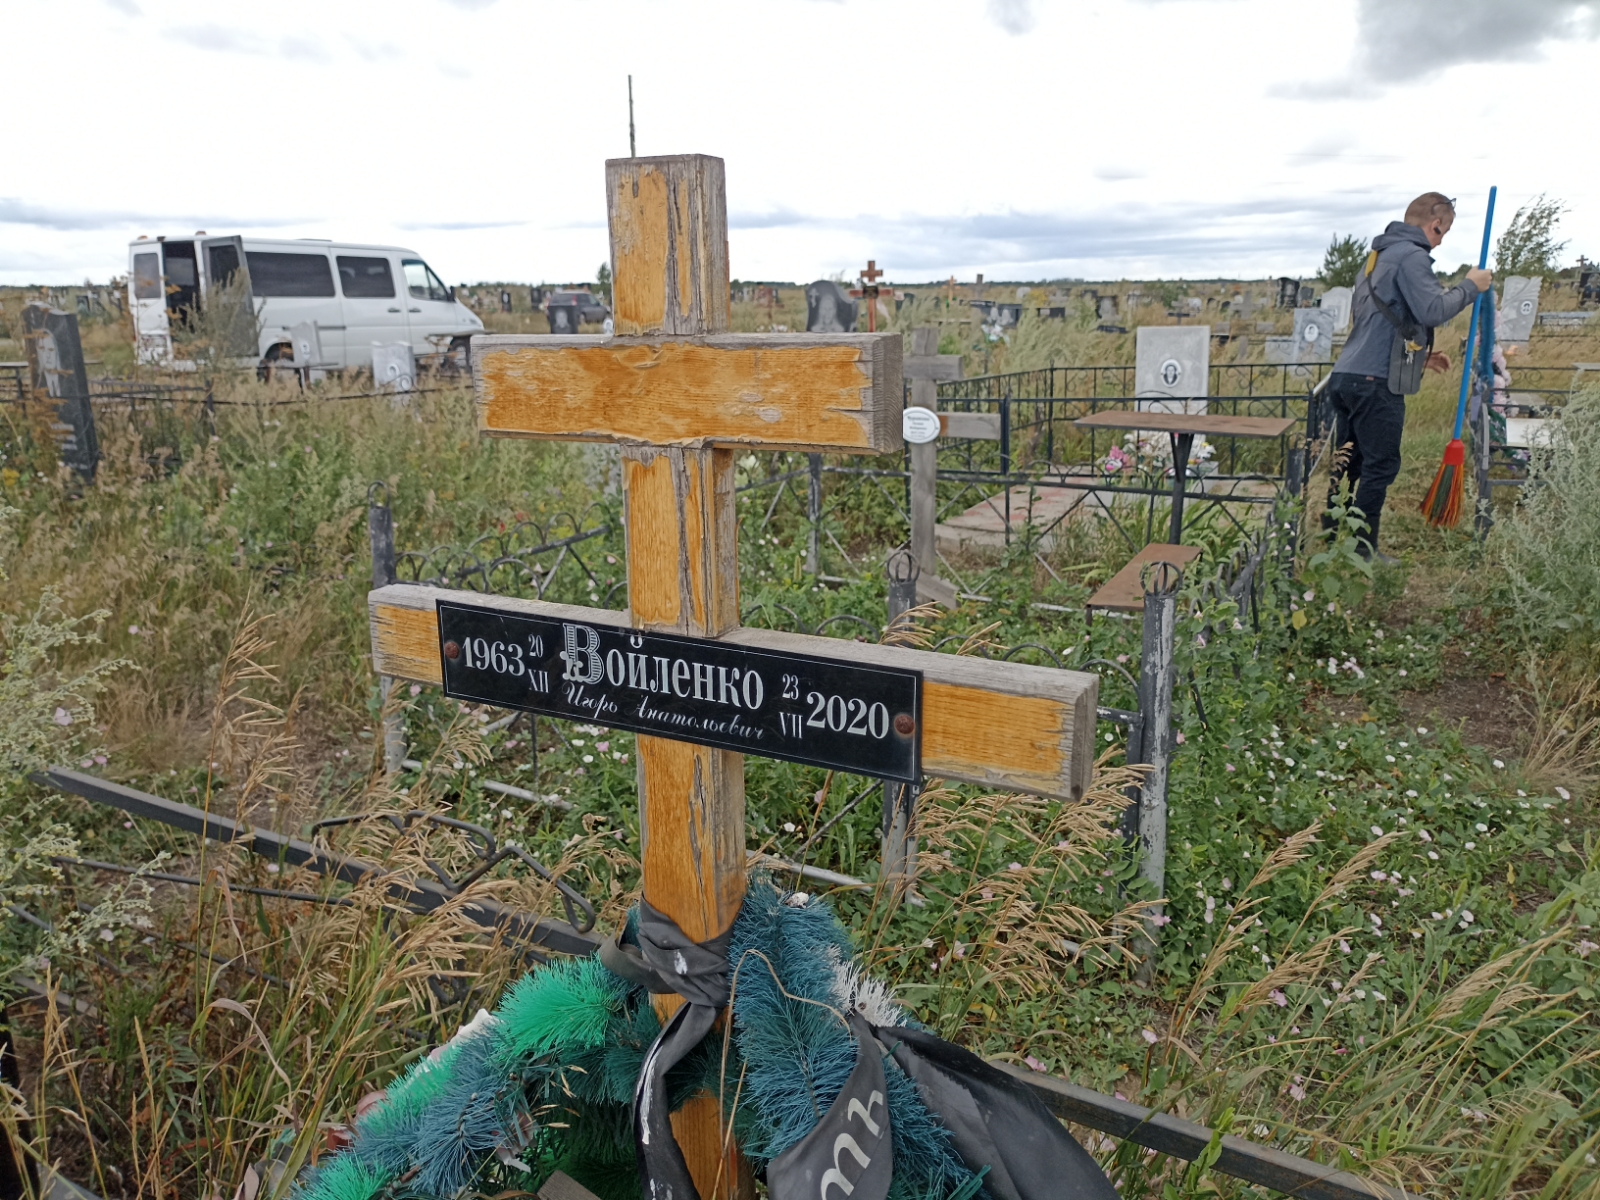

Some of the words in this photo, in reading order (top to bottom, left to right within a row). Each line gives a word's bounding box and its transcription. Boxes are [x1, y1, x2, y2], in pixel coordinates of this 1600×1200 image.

[462, 636, 526, 677] 1963
[528, 634, 544, 658] 20
[528, 668, 549, 693] XII
[559, 622, 764, 711] Войленко
[782, 673, 799, 700] 23
[562, 681, 618, 720] Игорь
[626, 694, 764, 740] Анатольевич
[779, 711, 803, 739] VII
[805, 691, 890, 740] 2020
